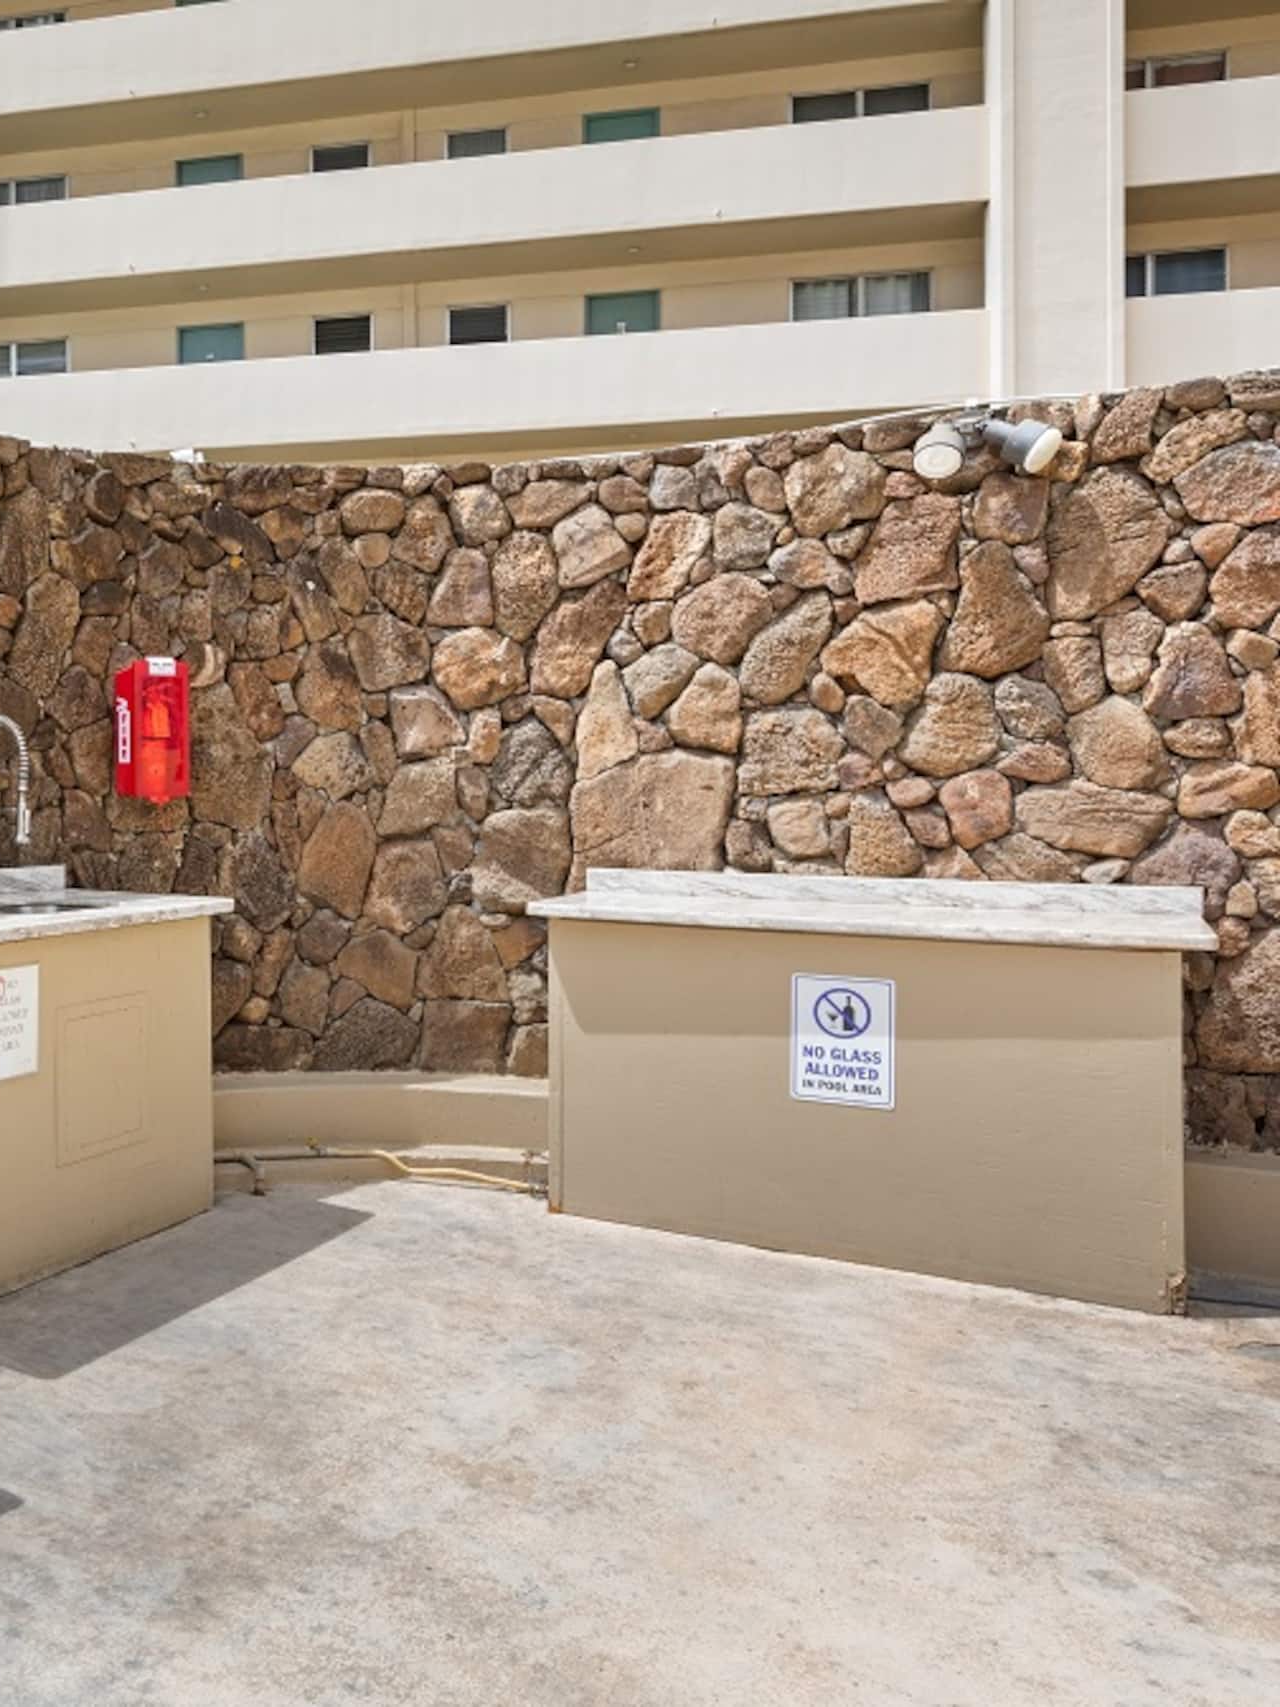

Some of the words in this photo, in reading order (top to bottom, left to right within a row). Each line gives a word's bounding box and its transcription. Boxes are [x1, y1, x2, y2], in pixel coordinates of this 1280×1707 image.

[802, 1045, 825, 1060] NO
[830, 1047, 882, 1065] GLASS
[804, 1061, 880, 1080] ALLOWED
[801, 1079, 815, 1089] IN
[817, 1079, 849, 1093] POOL
[852, 1083, 883, 1096] AREA
